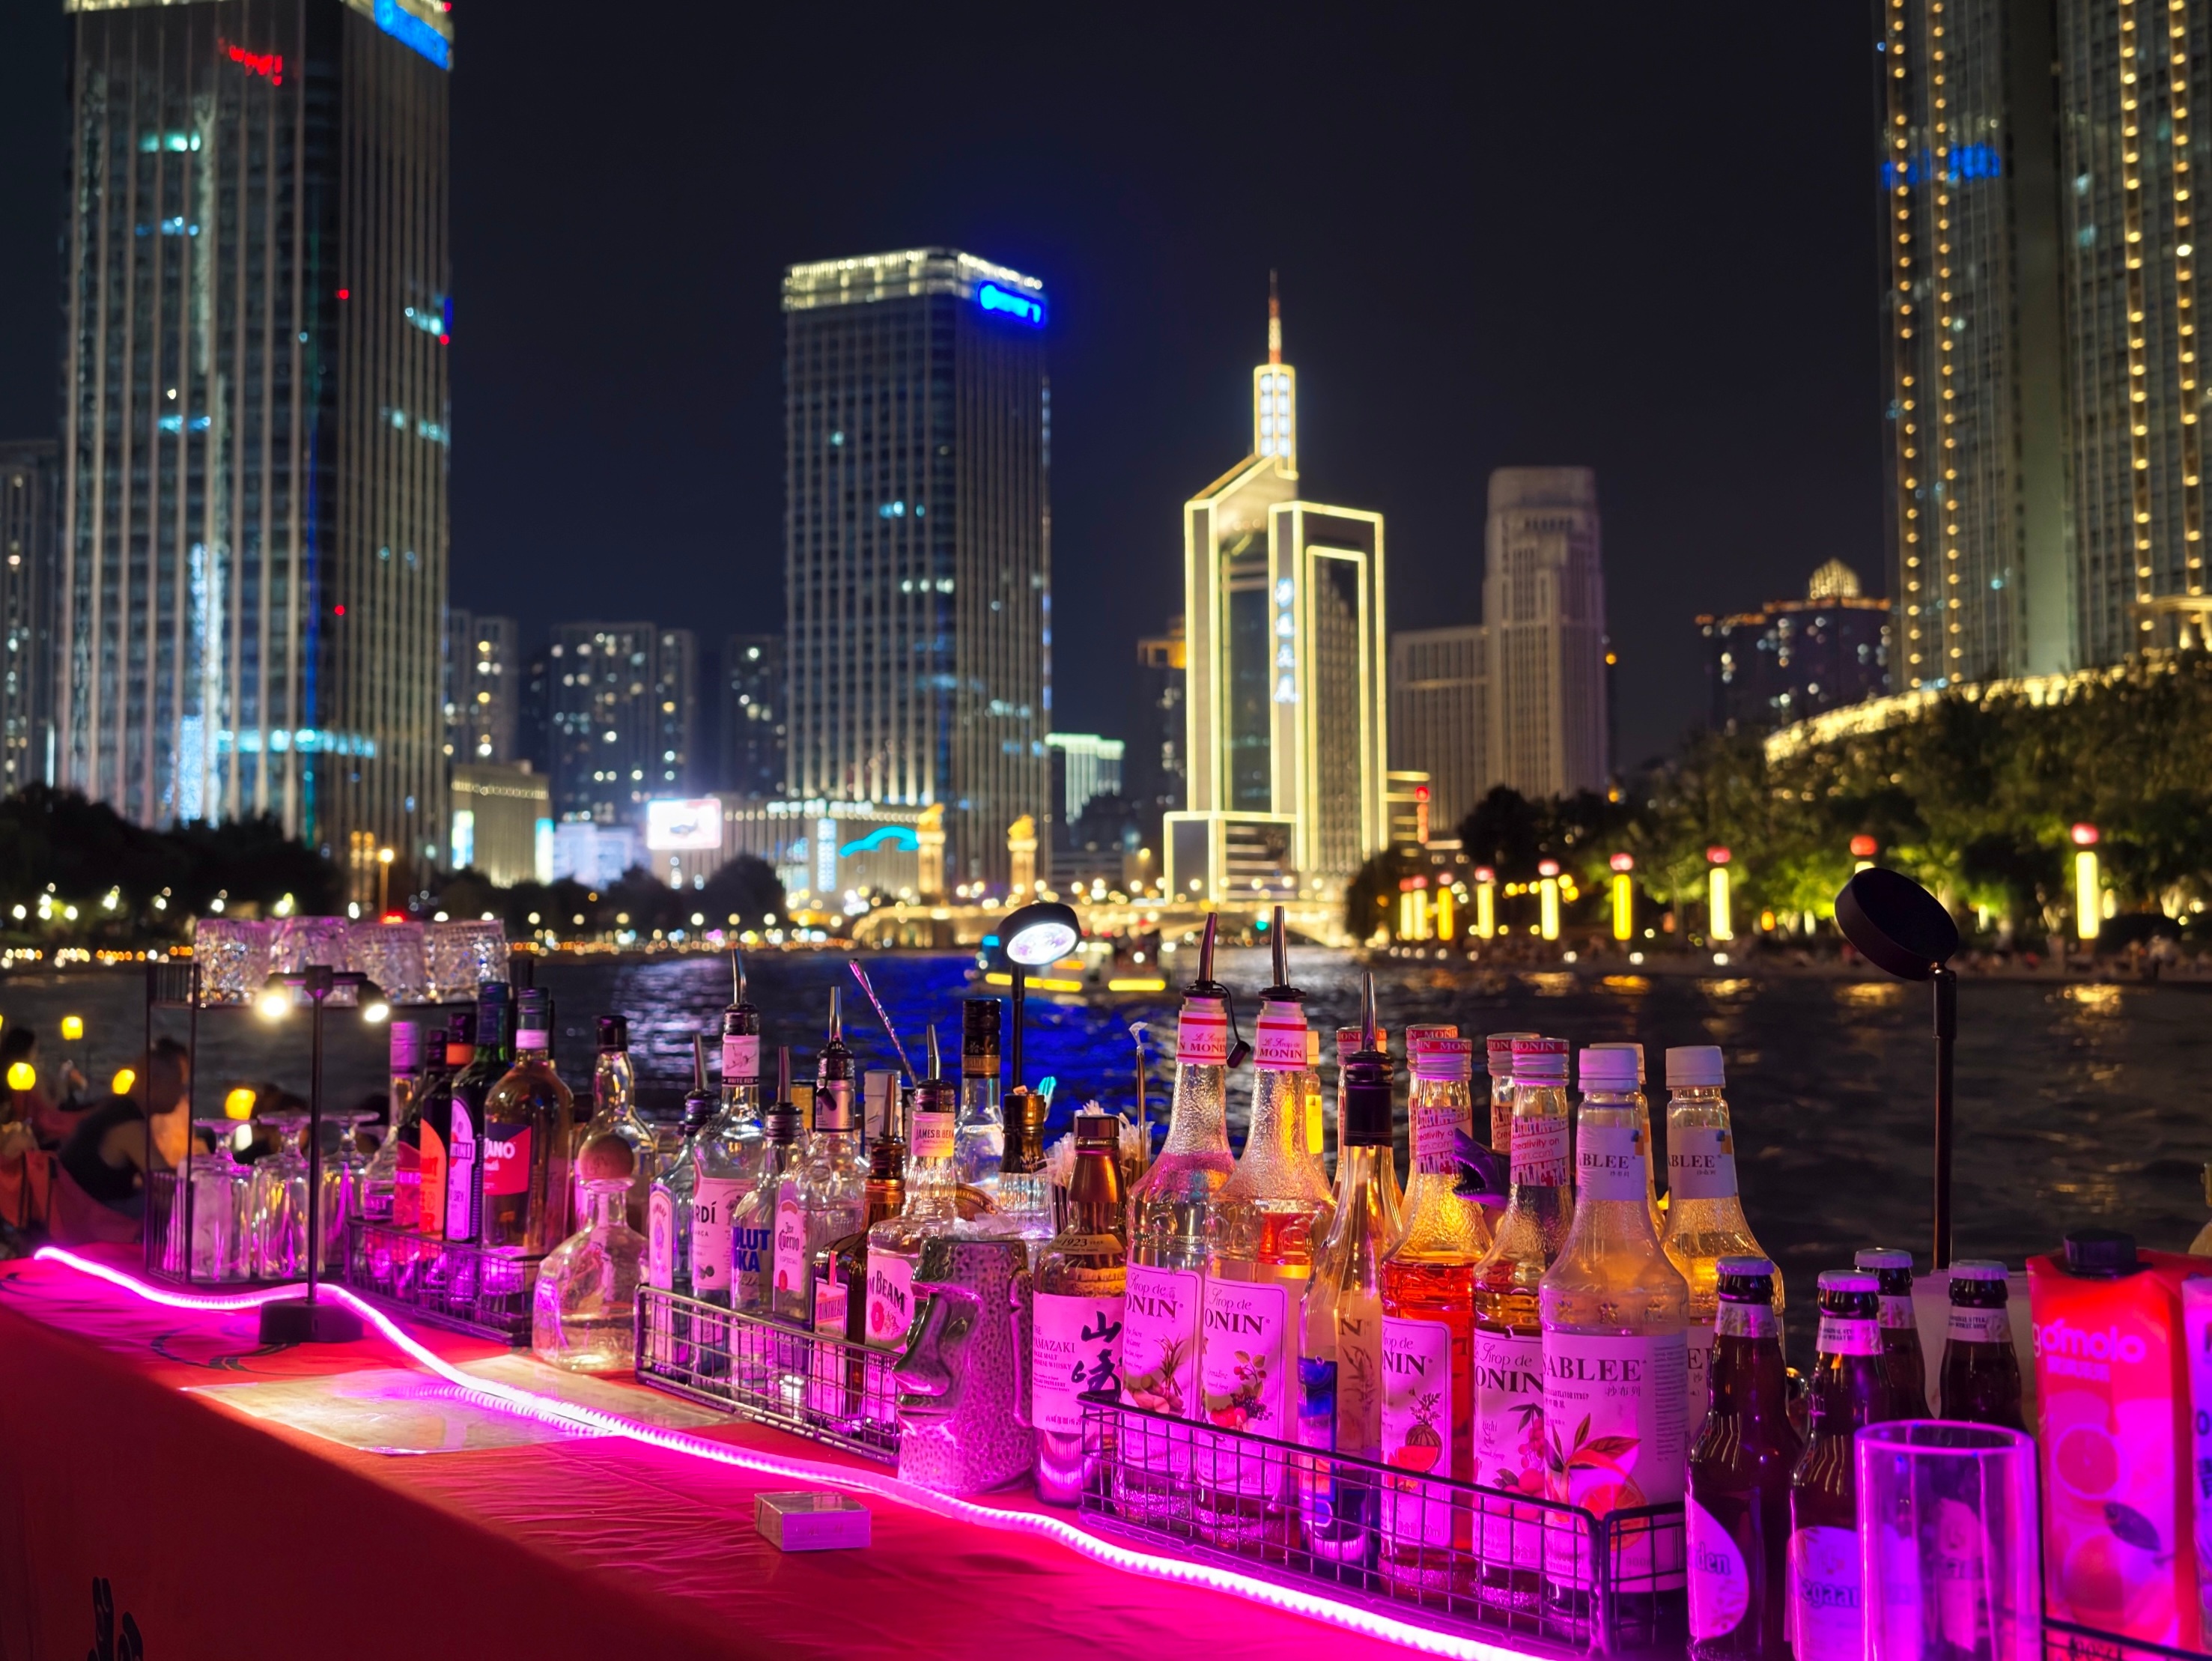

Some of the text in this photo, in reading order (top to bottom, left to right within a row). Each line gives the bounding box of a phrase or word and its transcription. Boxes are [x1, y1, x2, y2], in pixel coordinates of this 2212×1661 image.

[1260, 1048, 1302, 1059] MONIN
[1513, 1041, 1555, 1051] MONIN
[915, 1129, 935, 1141] JAMES
[1512, 1137, 1560, 1152] Creativity on
[778, 1228, 800, 1252] Cuervo
[1061, 1237, 1088, 1248] 1923
[876, 1269, 906, 1317] BEAM
[1128, 1272, 1167, 1298] Sirop de
[1209, 1287, 1252, 1313] Sirop de
[1204, 1308, 1265, 1336] ONIN
[1339, 1318, 1364, 1337] N
[1399, 1337, 1414, 1350] de
[1480, 1342, 1511, 1370] Sirop
[1514, 1354, 1533, 1367] de
[1049, 1361, 1072, 1371] WHISKY
